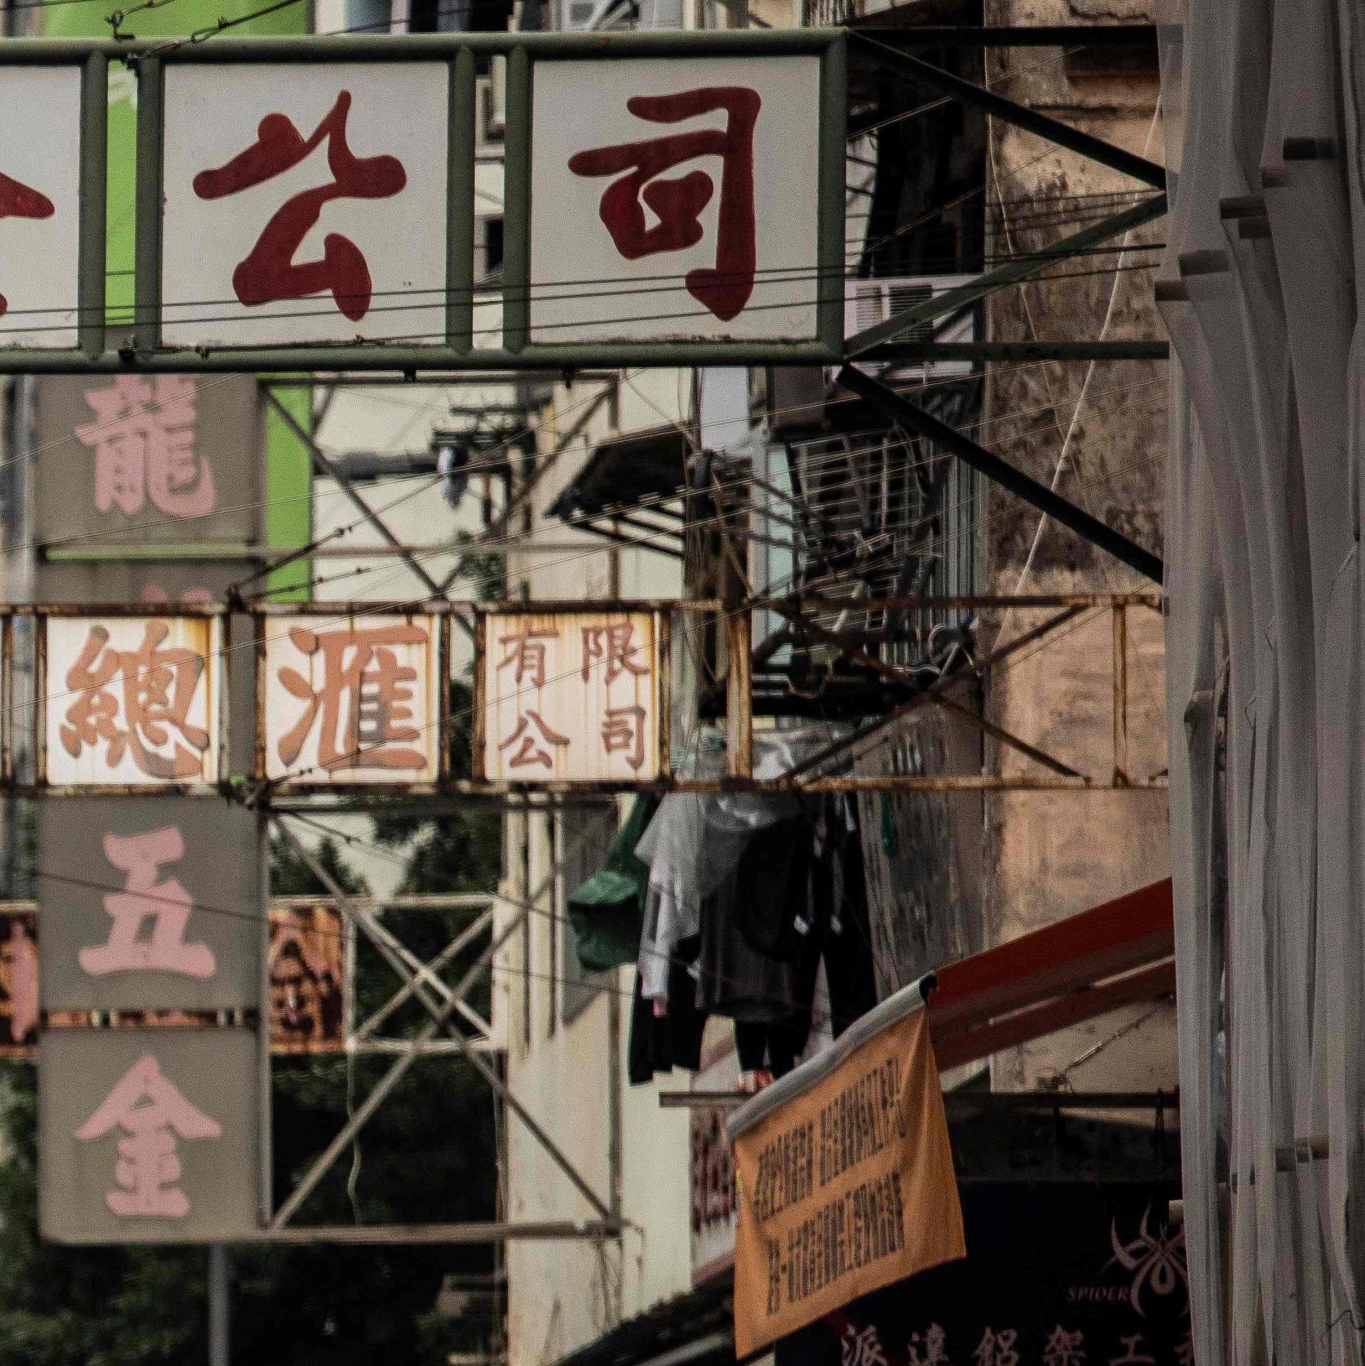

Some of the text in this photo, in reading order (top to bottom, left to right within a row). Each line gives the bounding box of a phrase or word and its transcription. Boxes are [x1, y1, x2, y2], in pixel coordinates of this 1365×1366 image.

[495, 620, 651, 688] 有限
[497, 704, 648, 771] 公司
[1067, 1285, 1129, 1302] SPIDER
